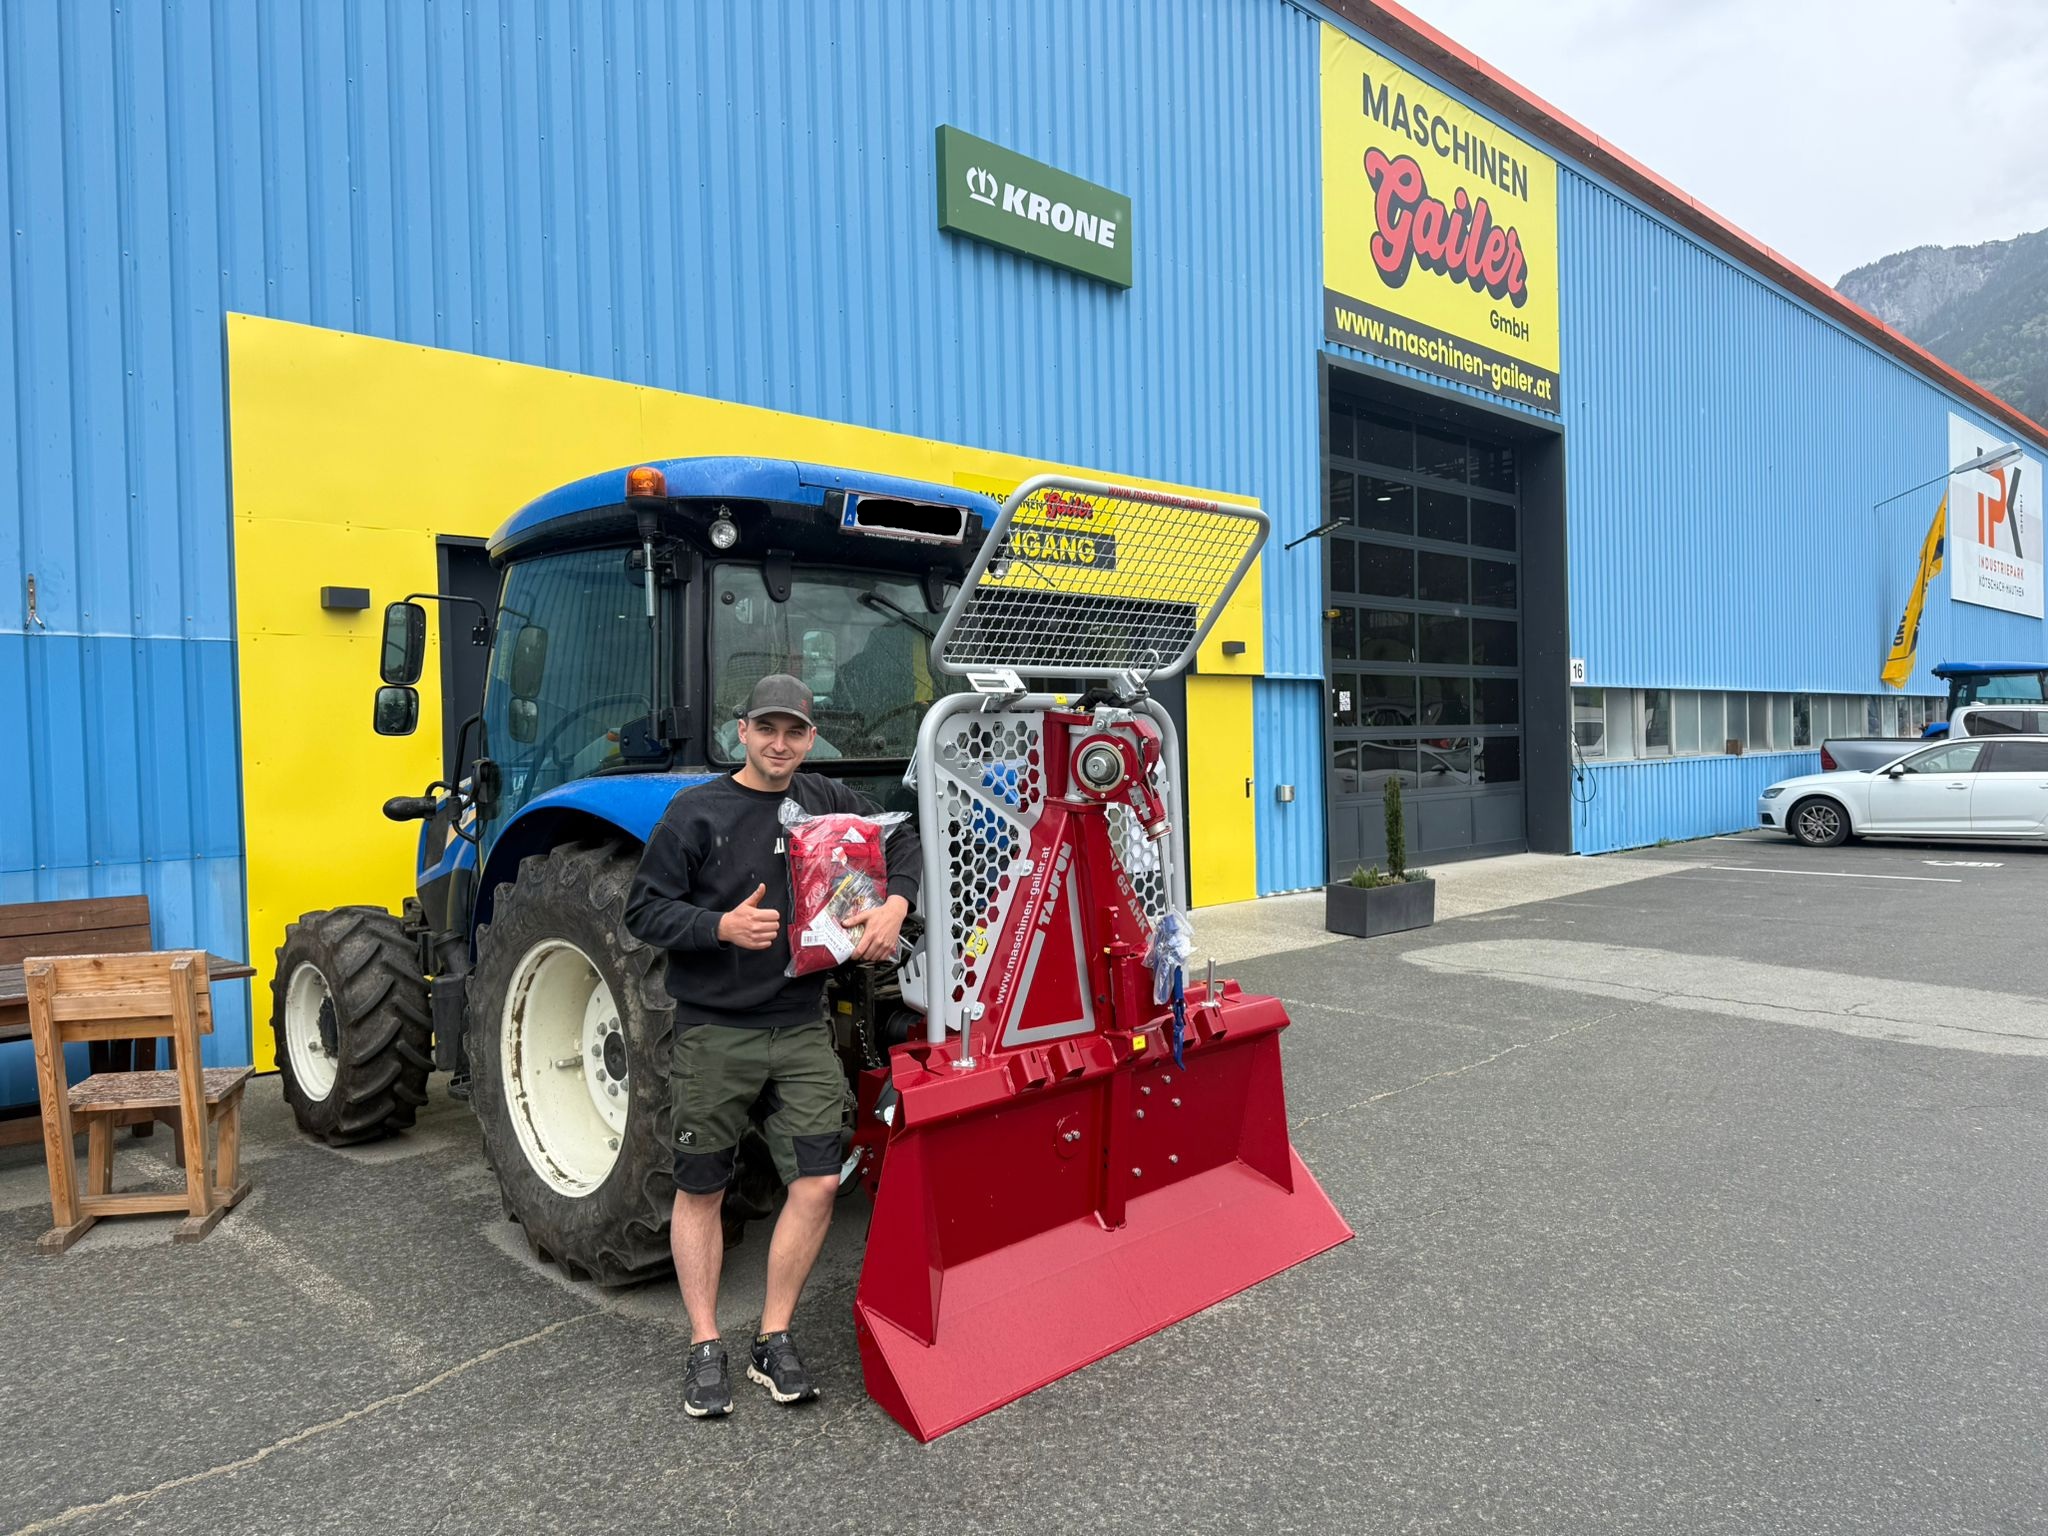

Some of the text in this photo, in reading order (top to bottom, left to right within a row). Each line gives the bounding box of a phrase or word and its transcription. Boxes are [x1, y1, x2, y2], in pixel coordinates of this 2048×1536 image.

[1362, 72, 1528, 202] MASCHINEN
[1002, 182, 1117, 249] KRONE
[1364, 147, 1528, 308] Gailer
[1335, 306, 1552, 400] www.maschinen-gailer.at
[1490, 309, 1530, 342] GmbH
[1009, 530, 1097, 564] NGANG
[1978, 554, 2024, 581] INDUSTRIEPARK
[1573, 663, 1583, 679] 16
[1038, 841, 1073, 926] TAJFUN
[1117, 874, 1130, 896] 65
[1128, 898, 1148, 934] AHK
[995, 846, 1052, 1005] www.maschinen-gailer.at
